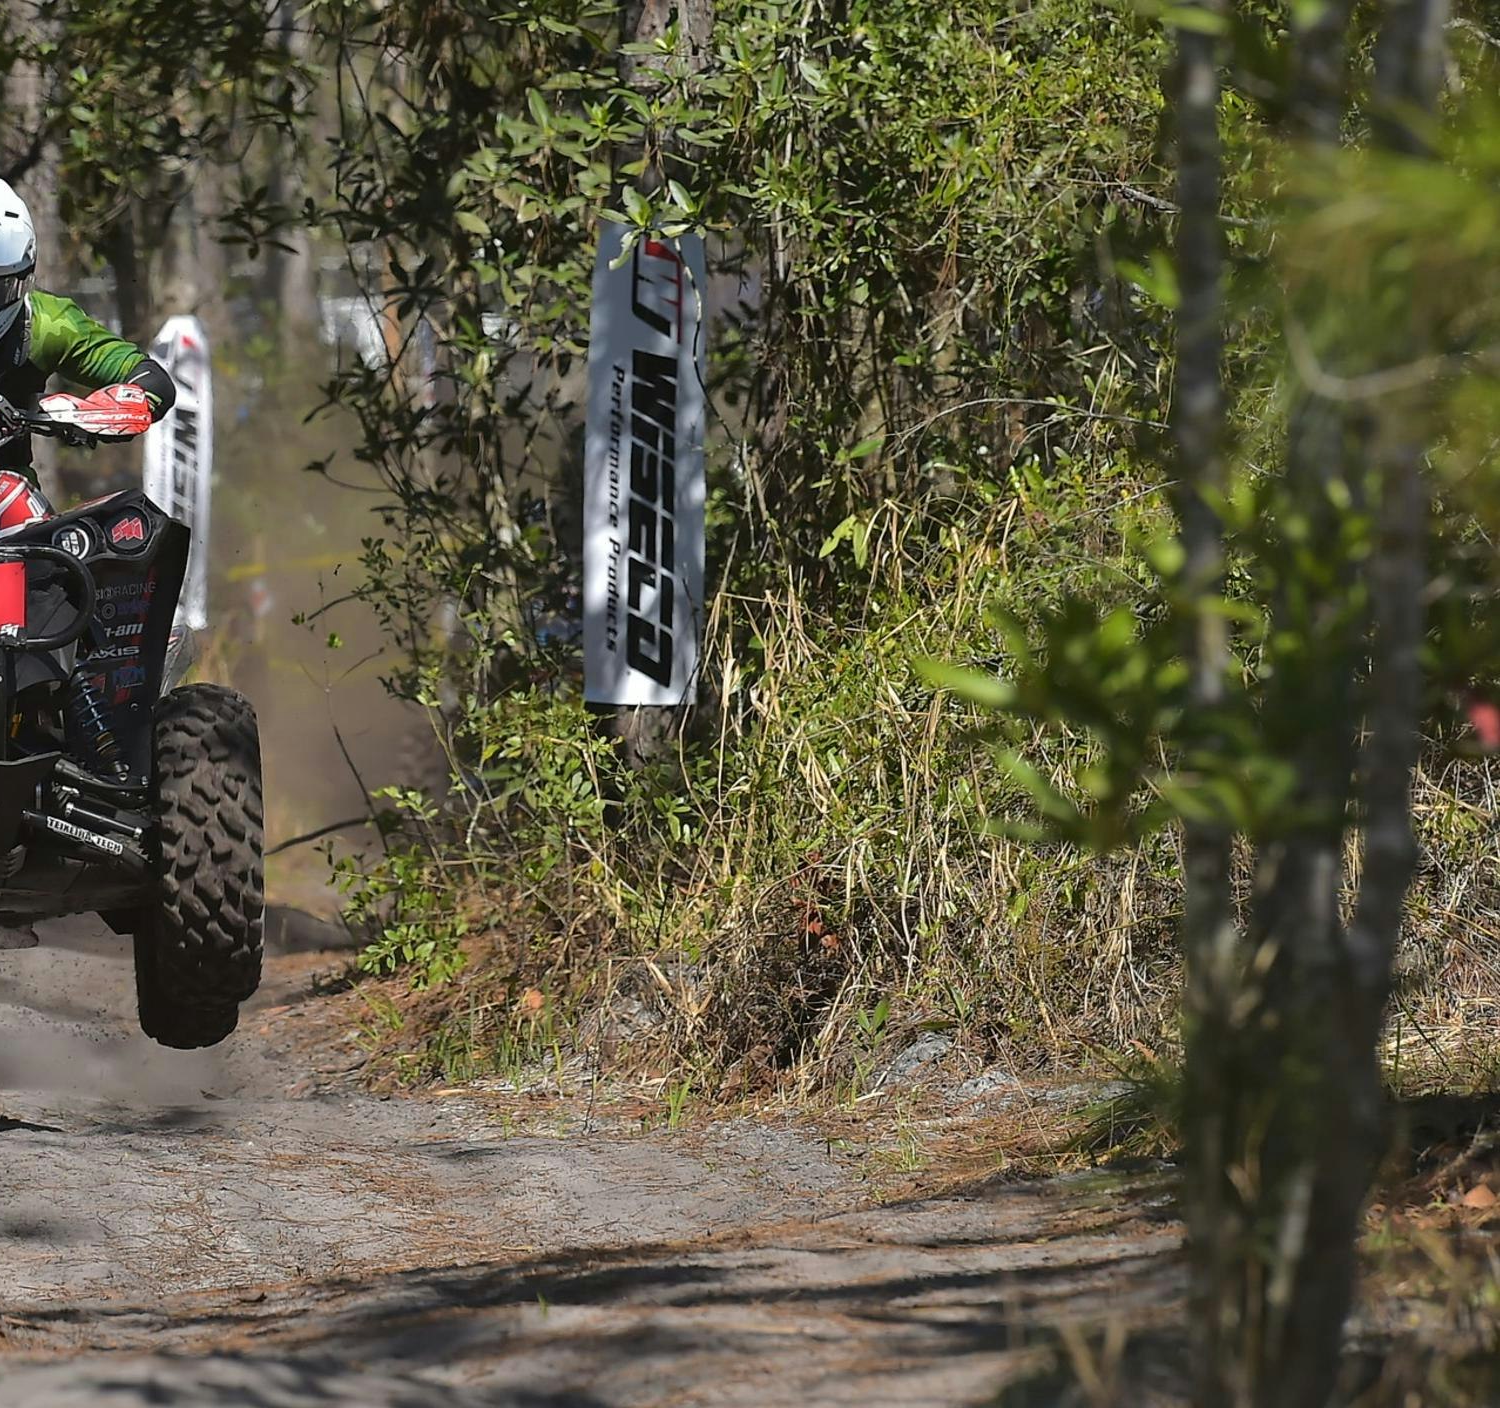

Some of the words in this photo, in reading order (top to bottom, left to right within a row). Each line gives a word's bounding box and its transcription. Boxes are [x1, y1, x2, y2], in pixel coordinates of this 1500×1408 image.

[609, 364, 626, 531] Performance
[626, 349, 678, 688] WISECO
[605, 537, 622, 652] Products
[86, 646, 141, 661] AXIS
[97, 838, 121, 853] TECH
